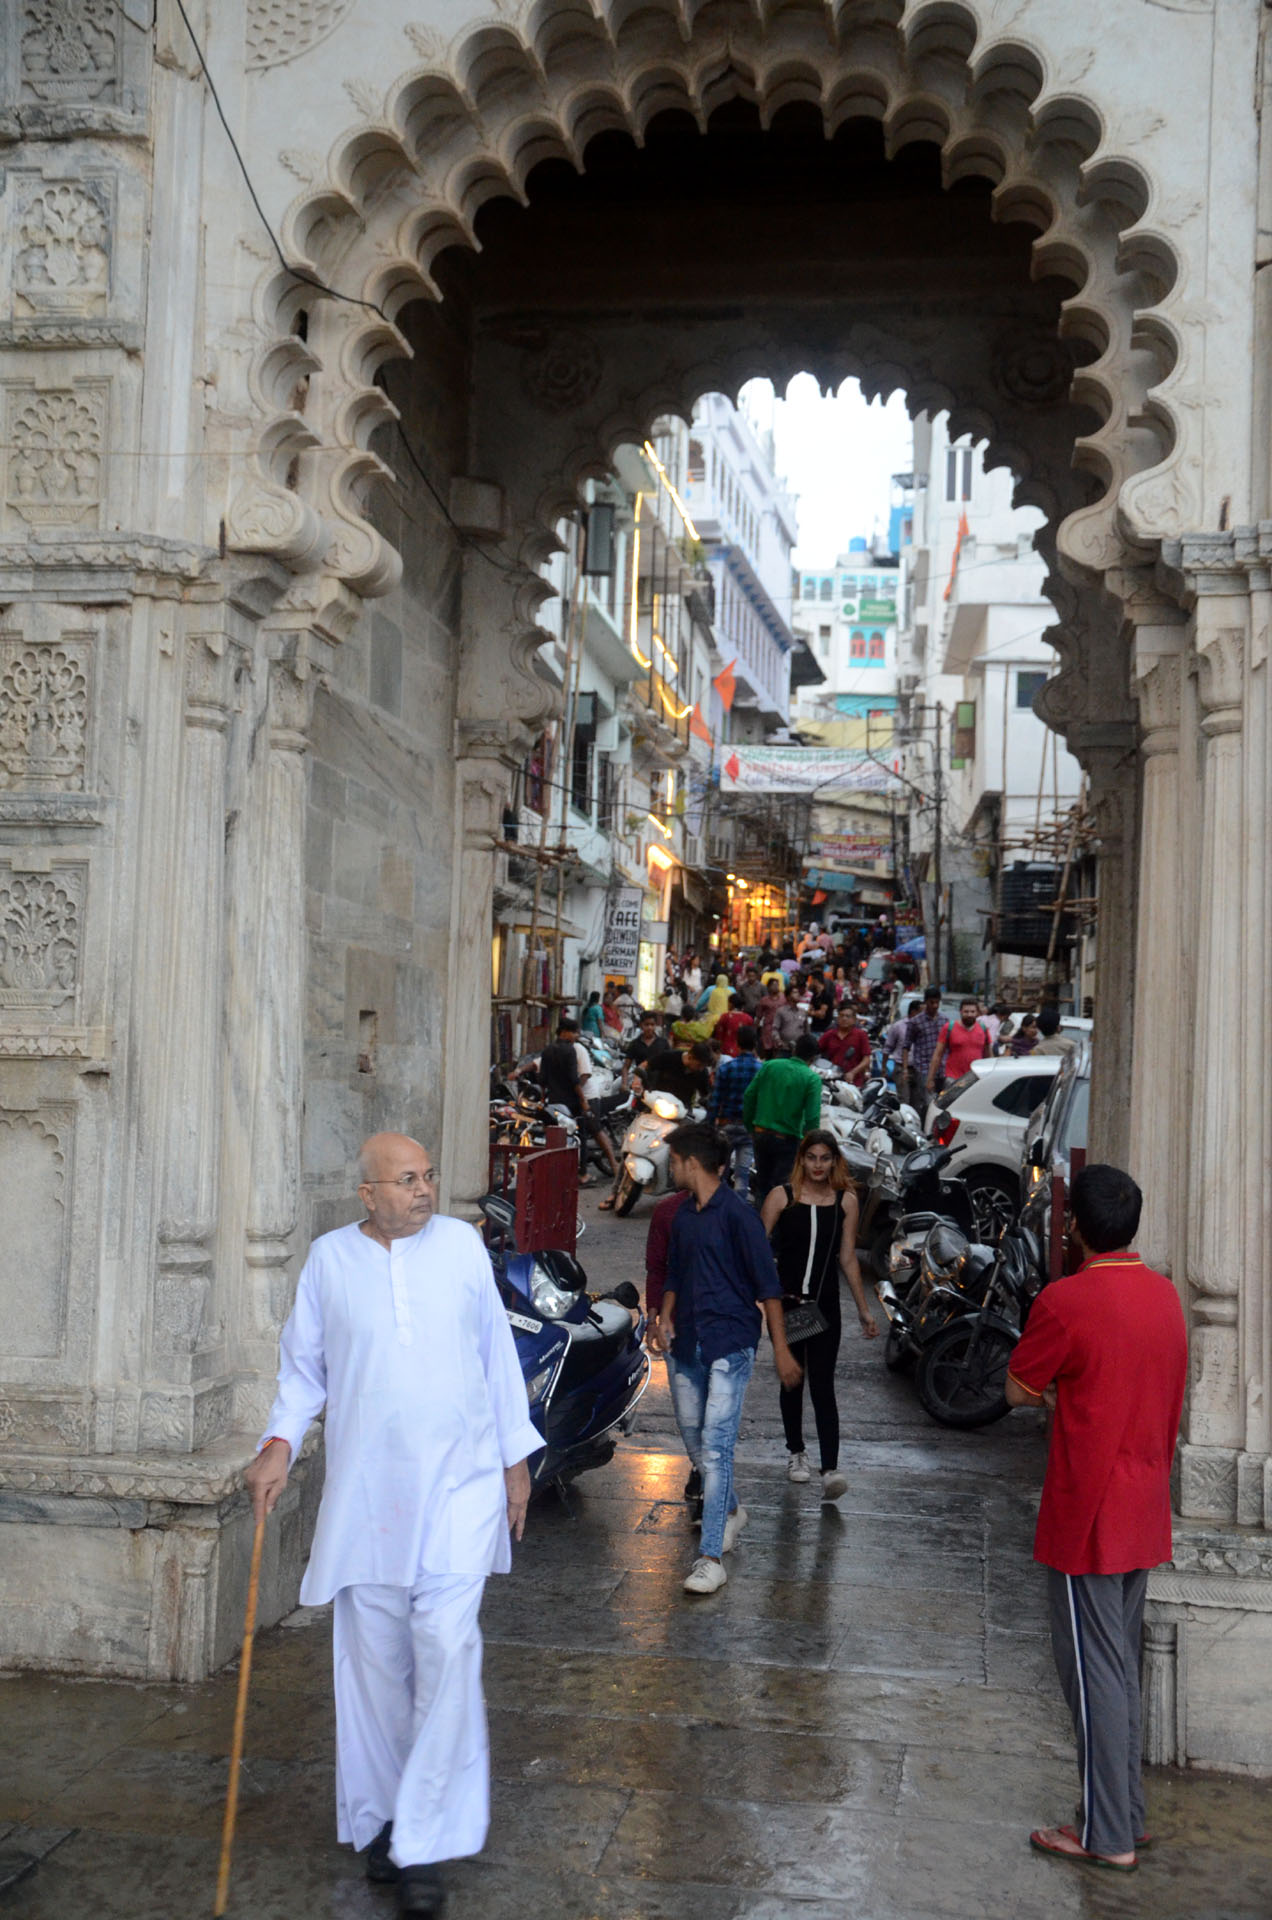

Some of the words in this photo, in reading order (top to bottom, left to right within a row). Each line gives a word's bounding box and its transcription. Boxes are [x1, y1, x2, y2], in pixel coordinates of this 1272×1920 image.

[609, 911, 639, 927] CAFE
[607, 945, 636, 957] GERMAN
[604, 958, 634, 968] BAKERY
